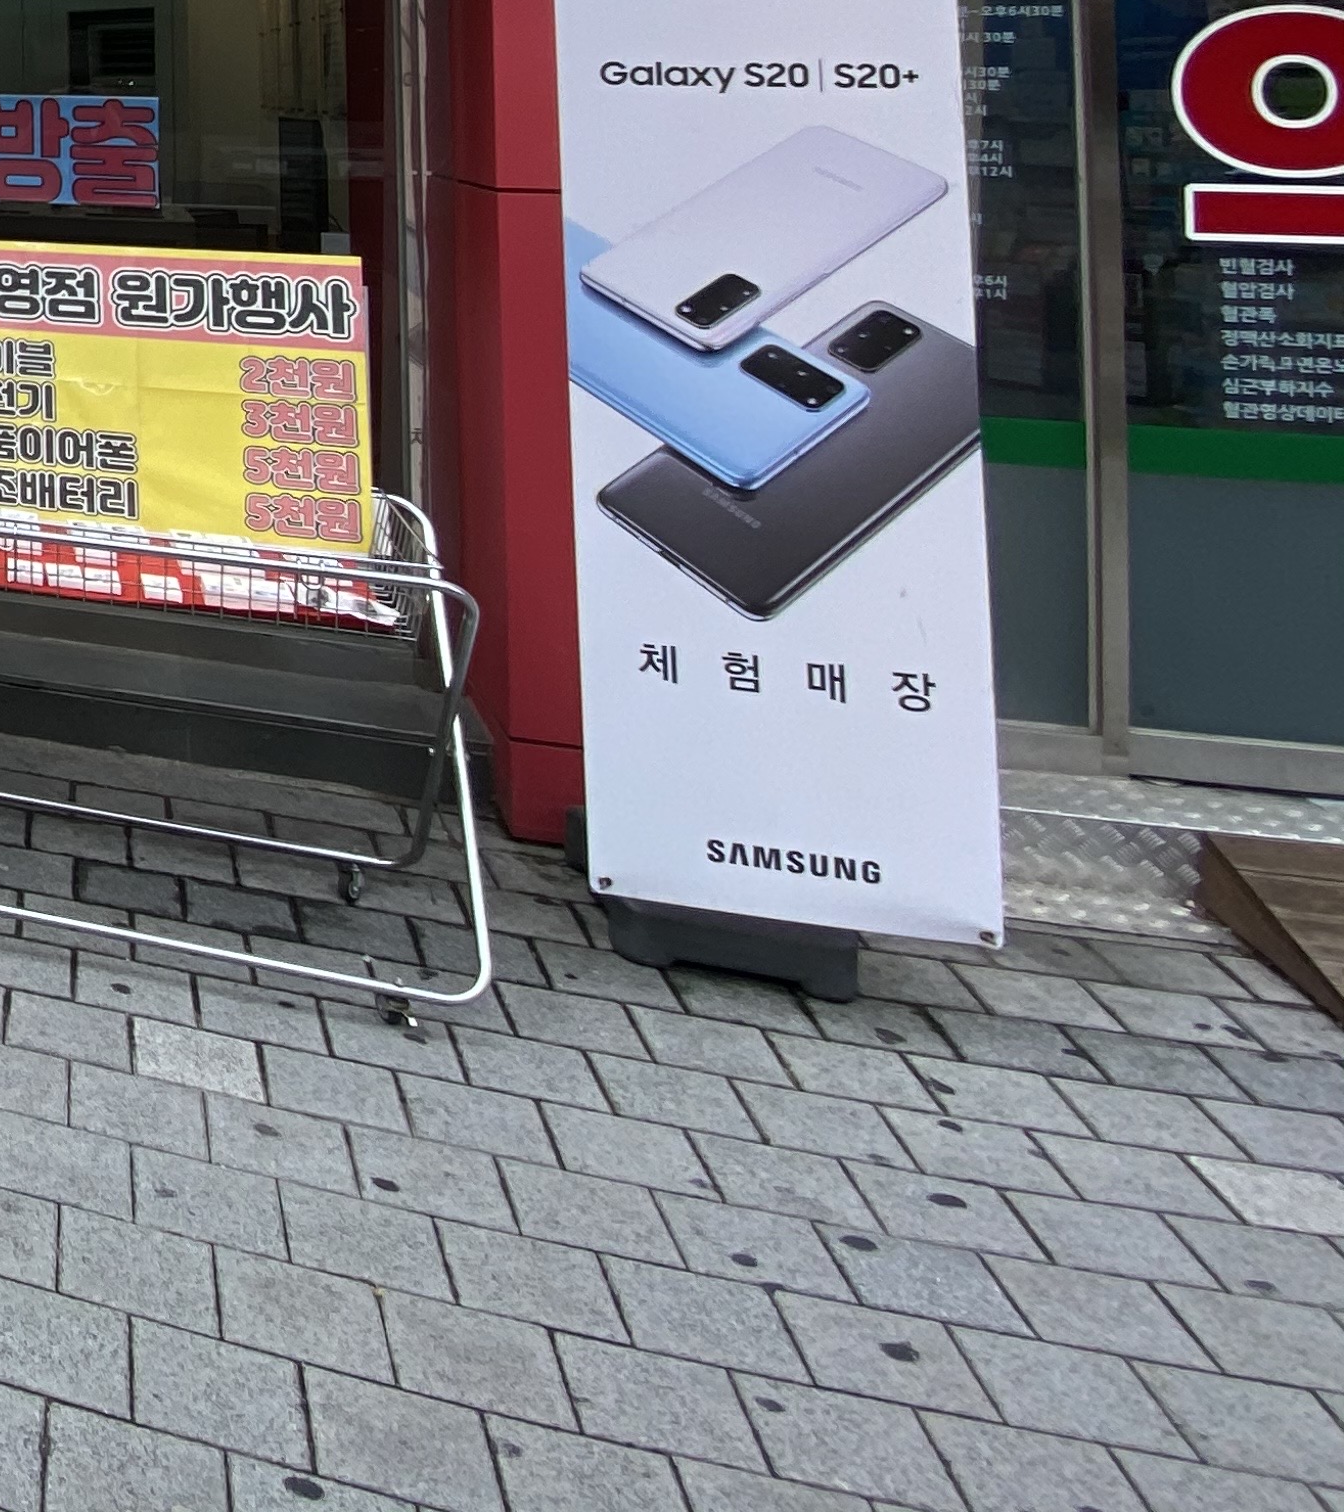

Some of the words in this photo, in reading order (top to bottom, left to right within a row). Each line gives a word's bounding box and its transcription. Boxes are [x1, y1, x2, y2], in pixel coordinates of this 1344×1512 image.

[600, 60, 736, 94] Galaxy
[744, 62, 810, 88] S20
[834, 63, 919, 90] S20+
[110, 271, 358, 341] 원가행사
[239, 355, 358, 405] 2천원
[240, 399, 360, 449] 3천원
[241, 444, 362, 496] 5천원
[243, 492, 365, 545] 5천원
[706, 838, 883, 885] SAMSUNG
